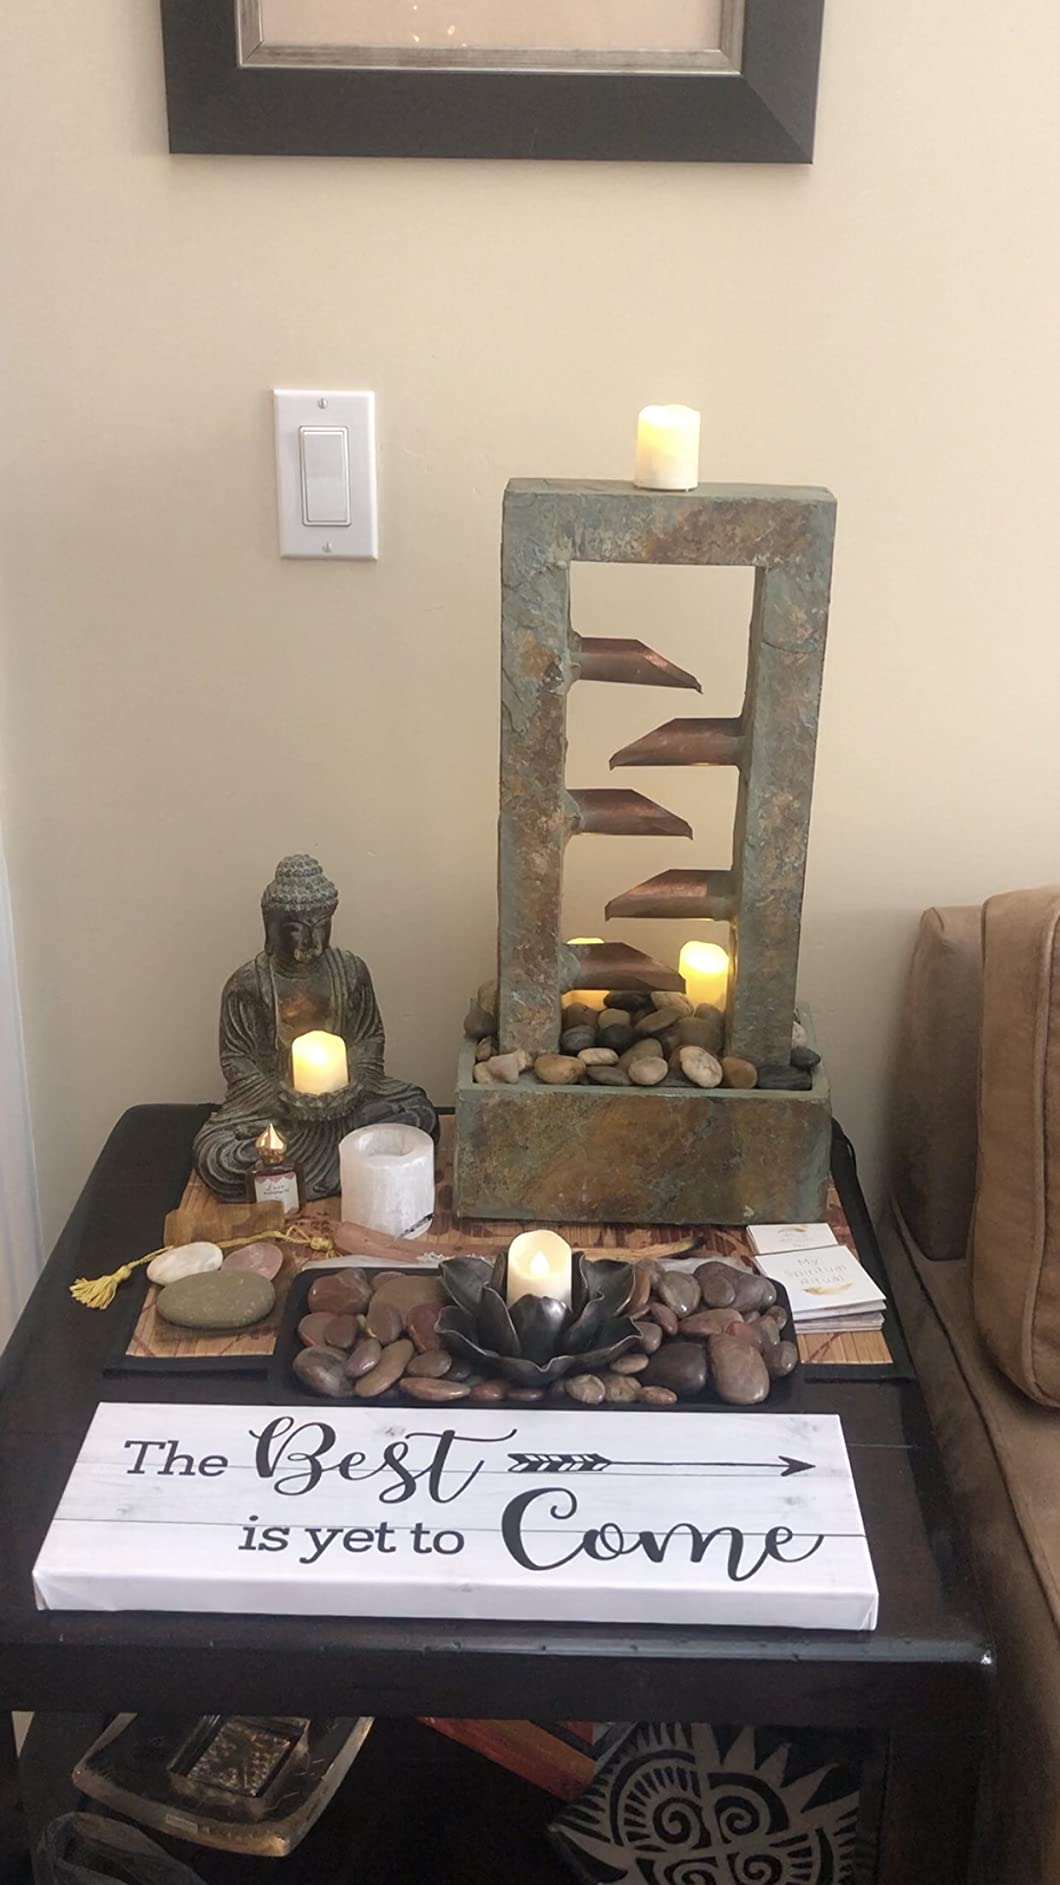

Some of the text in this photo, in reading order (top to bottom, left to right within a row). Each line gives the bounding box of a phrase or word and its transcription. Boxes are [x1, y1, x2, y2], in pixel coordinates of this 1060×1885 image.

[124, 1416, 517, 1504] The Best
[237, 1487, 825, 1582] is yet to Come
